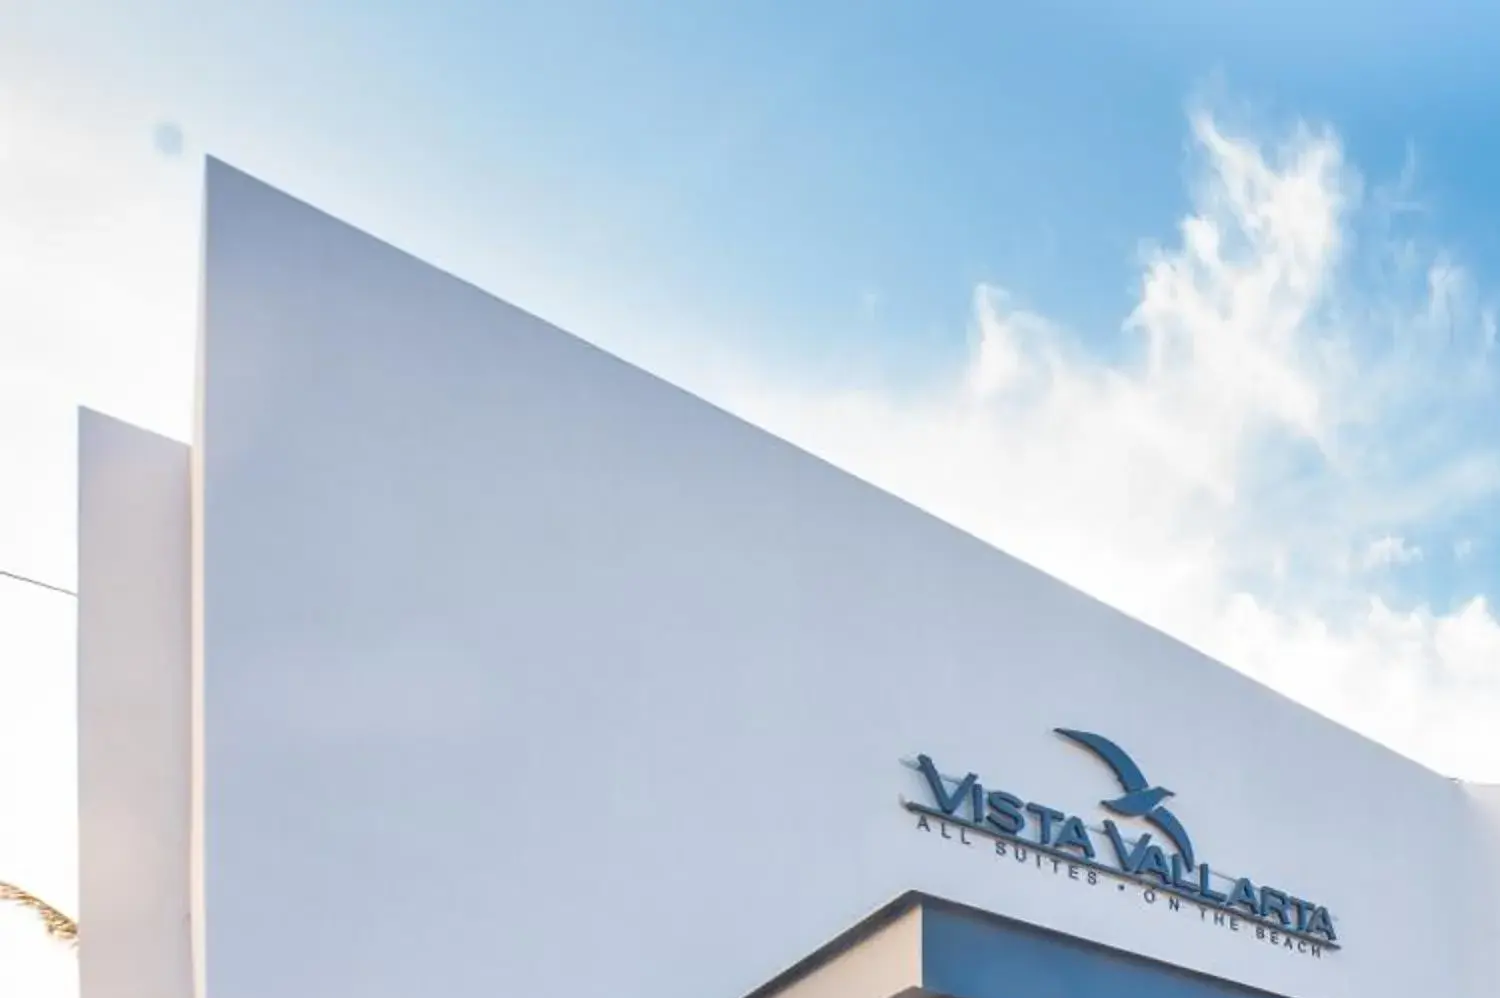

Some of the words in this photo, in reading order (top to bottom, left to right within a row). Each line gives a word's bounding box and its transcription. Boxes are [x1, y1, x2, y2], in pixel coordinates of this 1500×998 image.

[916, 814, 971, 846] ALL
[995, 840, 1098, 886] SUITES
[1143, 890, 1180, 913] ON
[1200, 909, 1240, 932] THE
[1255, 926, 1322, 959] BEACH
[917, 754, 1096, 858] VISTA
[1103, 819, 1337, 941] VALLARTA
